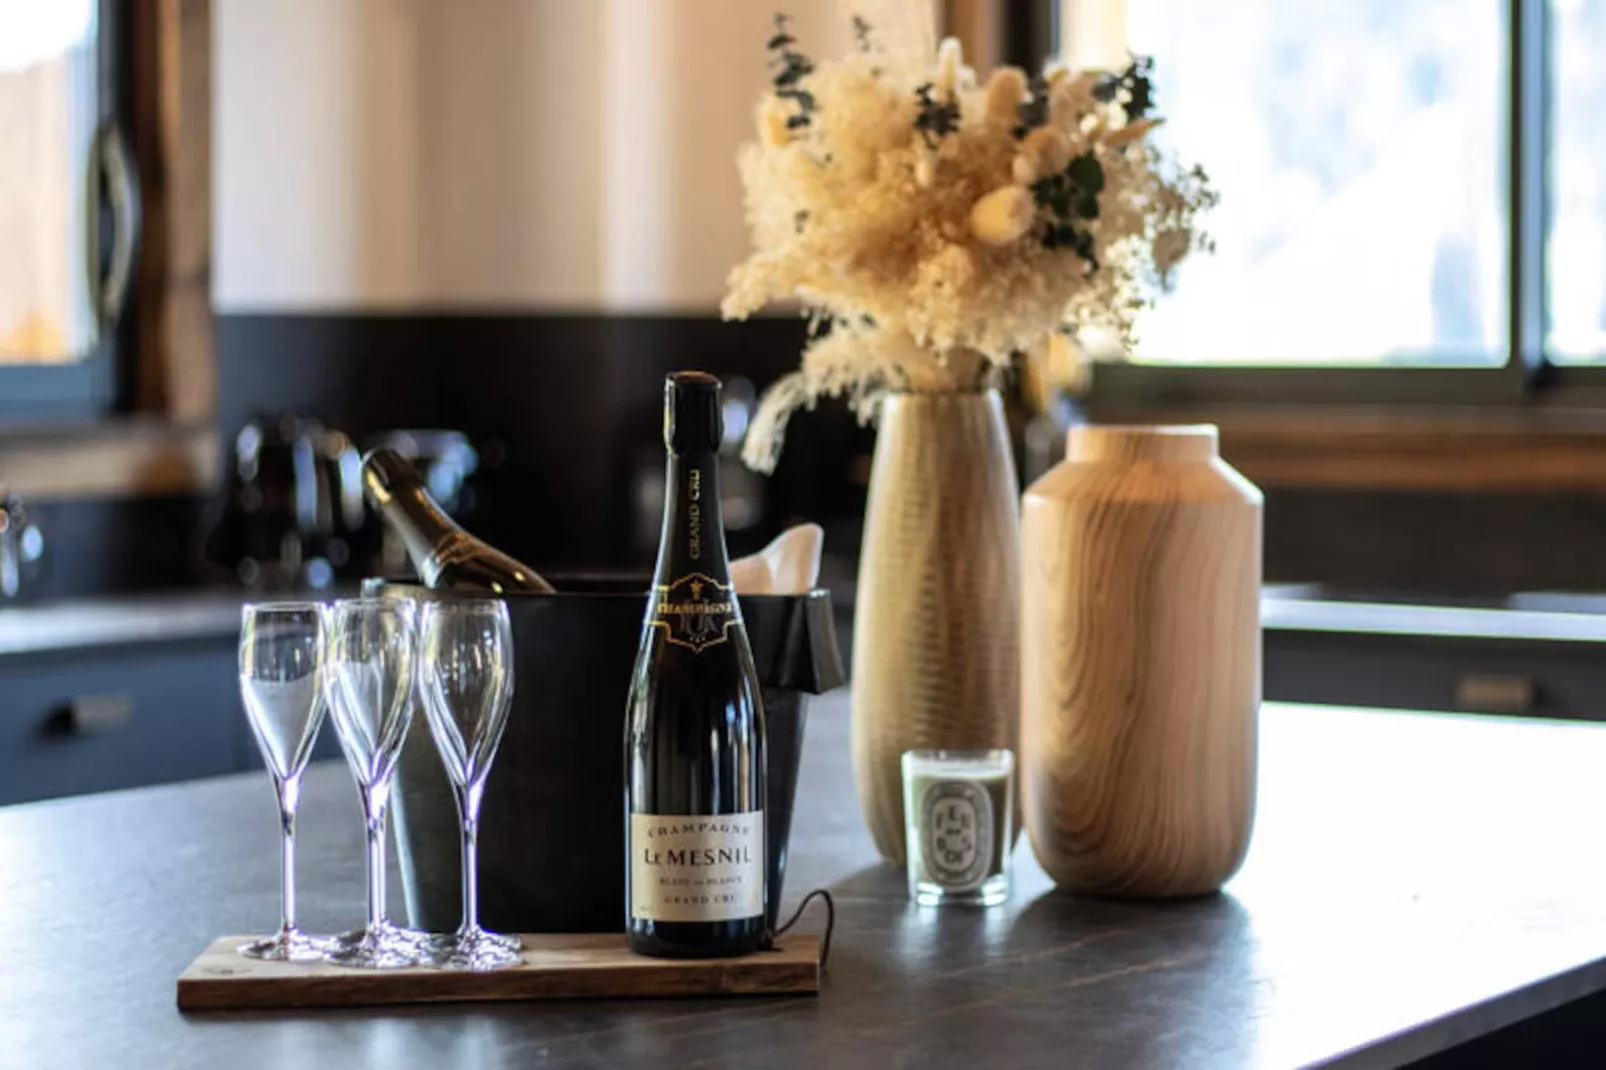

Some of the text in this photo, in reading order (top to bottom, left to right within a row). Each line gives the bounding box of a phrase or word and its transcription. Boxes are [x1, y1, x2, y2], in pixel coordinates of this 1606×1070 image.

[689, 469, 700, 560] GRAND CRU
[648, 822, 749, 838] CHAMPAGNE
[667, 846, 752, 866] MESNIL
